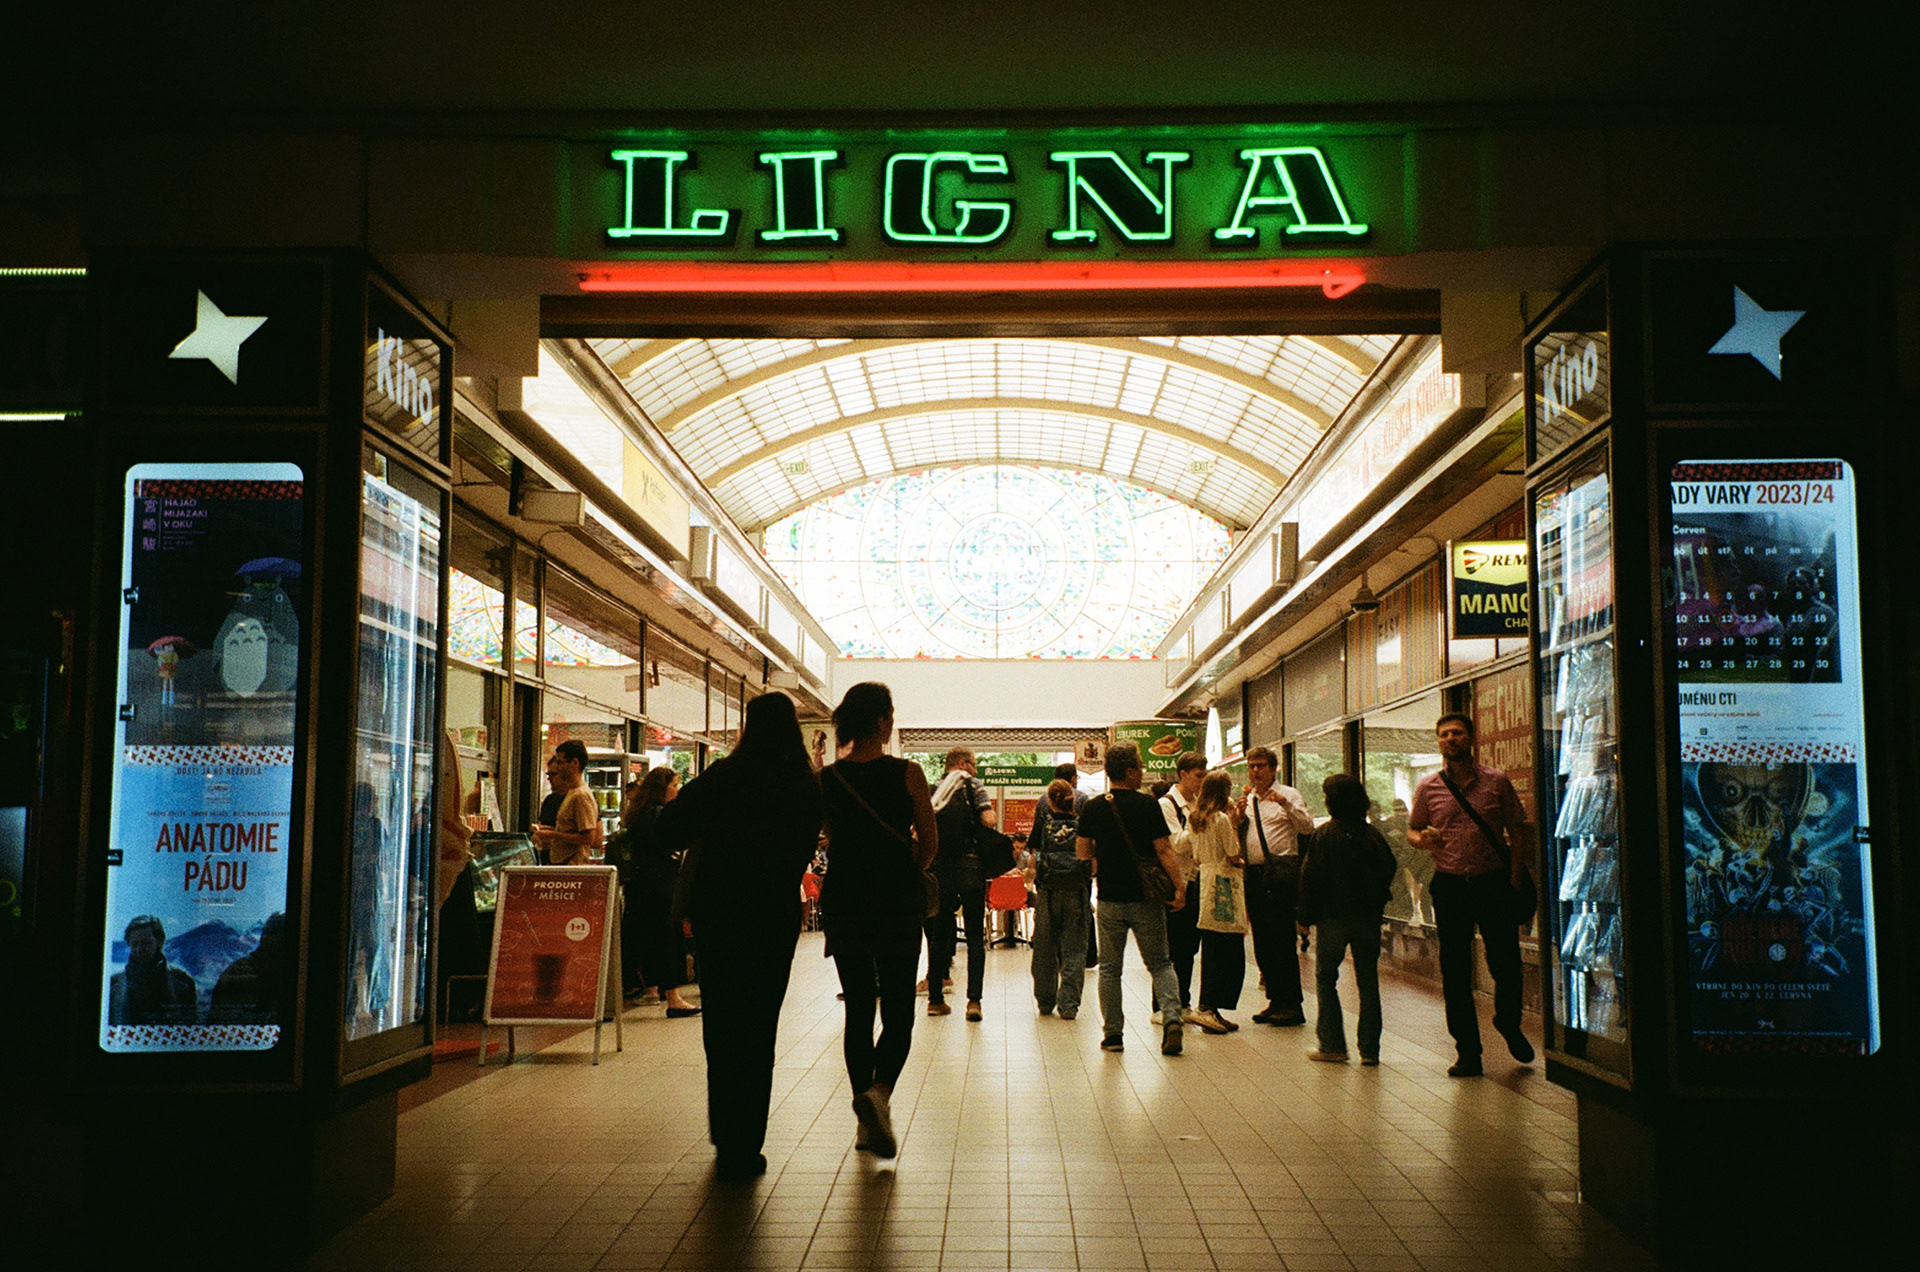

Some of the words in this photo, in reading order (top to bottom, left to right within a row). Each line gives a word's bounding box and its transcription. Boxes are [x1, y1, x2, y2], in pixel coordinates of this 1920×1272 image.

[606, 146, 1371, 247] LIGNA
[377, 326, 433, 426] Kino
[1543, 341, 1598, 427] Kino
[1705, 484, 1752, 504] VARY
[1756, 482, 1835, 506] 2023/24
[164, 499, 197, 507] HAJAO
[164, 509, 208, 518] MIJAZAKI
[163, 520, 170, 528] V
[172, 520, 193, 528] OKU
[1796, 569, 1801, 577] 1
[1818, 569, 1824, 577] 2
[1680, 592, 1686, 600] 3
[1703, 592, 1710, 600] 4
[1726, 592, 1732, 600] 5
[1749, 592, 1756, 600] 6
[1773, 592, 1779, 600] 7
[1796, 592, 1802, 600] 8
[1819, 592, 1825, 600] 9
[1676, 614, 1688, 623] 10
[1698, 614, 1710, 623] 11
[1721, 614, 1733, 623] 12
[1745, 614, 1756, 623] 13
[1791, 614, 1803, 623] 15
[1814, 614, 1827, 623] 16
[1677, 637, 1688, 646] 17
[1699, 637, 1711, 646] 18
[1722, 637, 1734, 646] 19
[1745, 637, 1758, 646] 20
[1769, 637, 1781, 646] 21
[1792, 637, 1804, 646] 22
[1815, 637, 1827, 646] 23
[1677, 660, 1689, 669] 24
[1700, 660, 1712, 669] 25
[1723, 660, 1735, 669] 26
[1746, 660, 1759, 669] 27
[1769, 660, 1782, 669] 28
[1793, 660, 1805, 669] 29
[1816, 660, 1829, 669] 30
[1718, 692, 1737, 706] CTI
[155, 822, 280, 853] ANATOMIE
[183, 854, 248, 891] PÁDU
[533, 881, 583, 890] PRODUKT
[538, 890, 576, 901] MĚSÍCE
